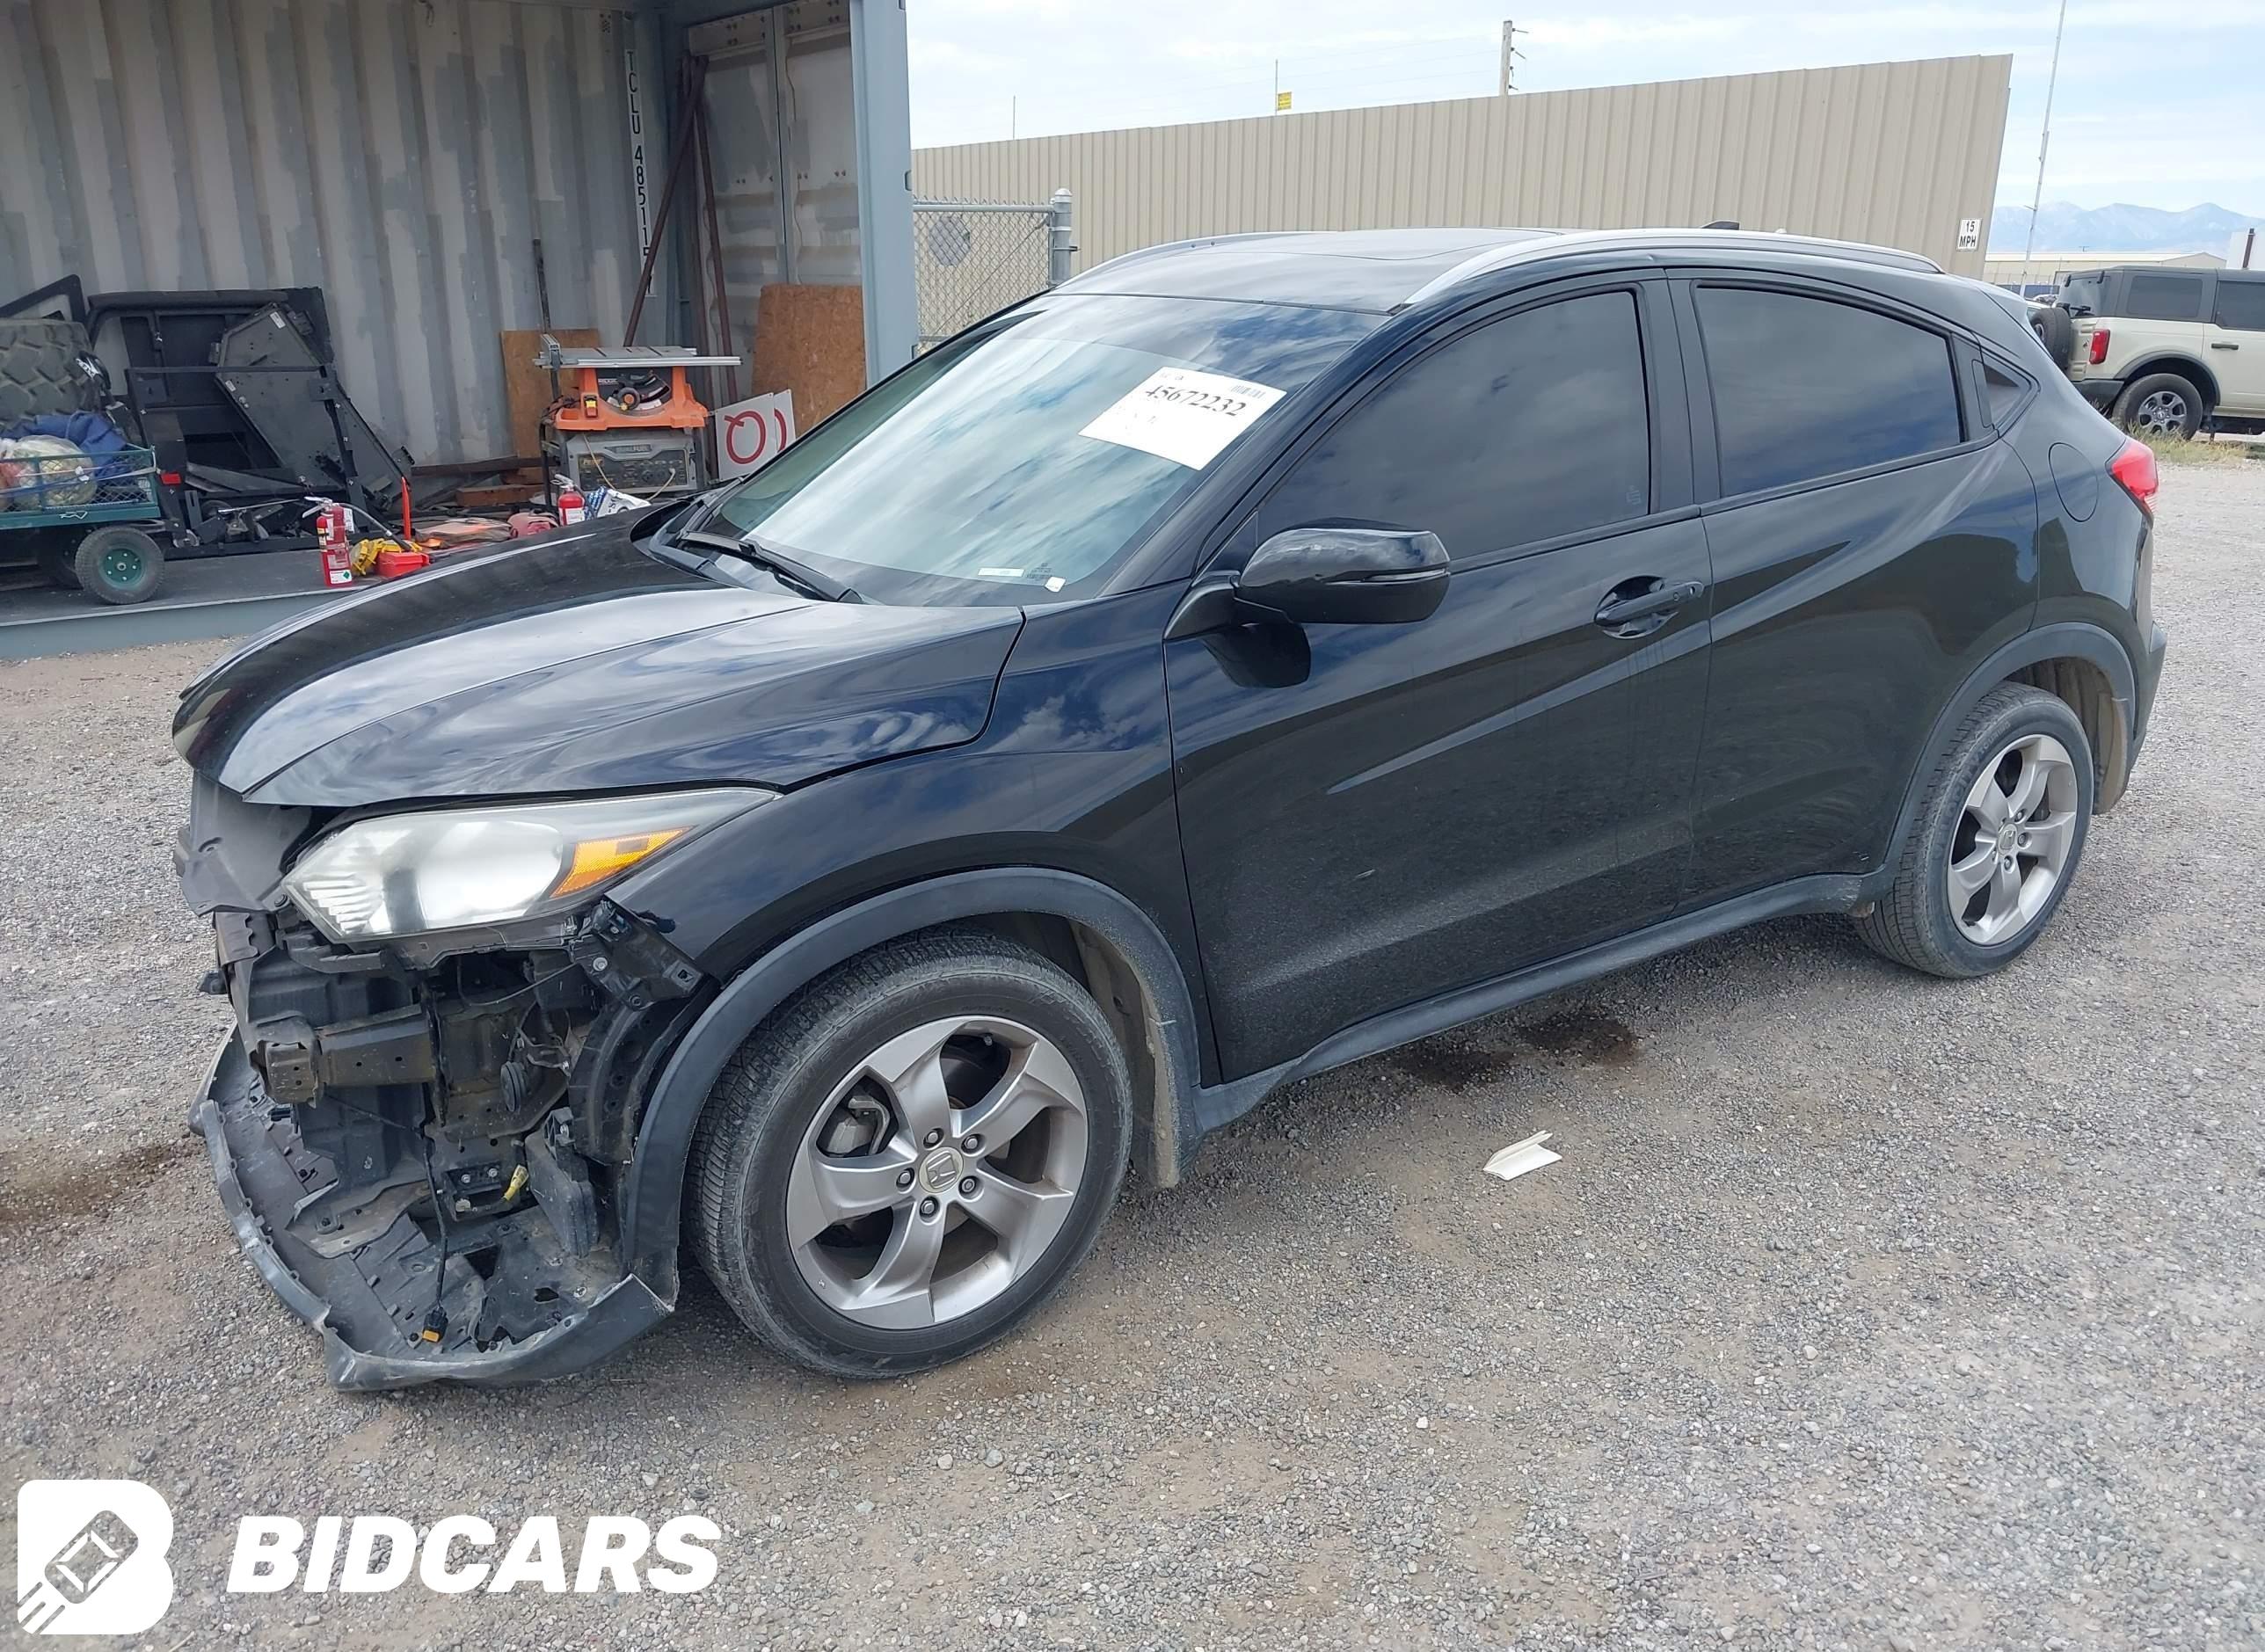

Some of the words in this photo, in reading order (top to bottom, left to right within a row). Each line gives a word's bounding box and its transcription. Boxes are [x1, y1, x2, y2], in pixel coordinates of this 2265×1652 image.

[626, 51, 641, 135] TCLU
[1966, 221, 1976, 232] 15
[1959, 236, 1977, 247] MPH
[1146, 385, 1247, 417] 45672232
